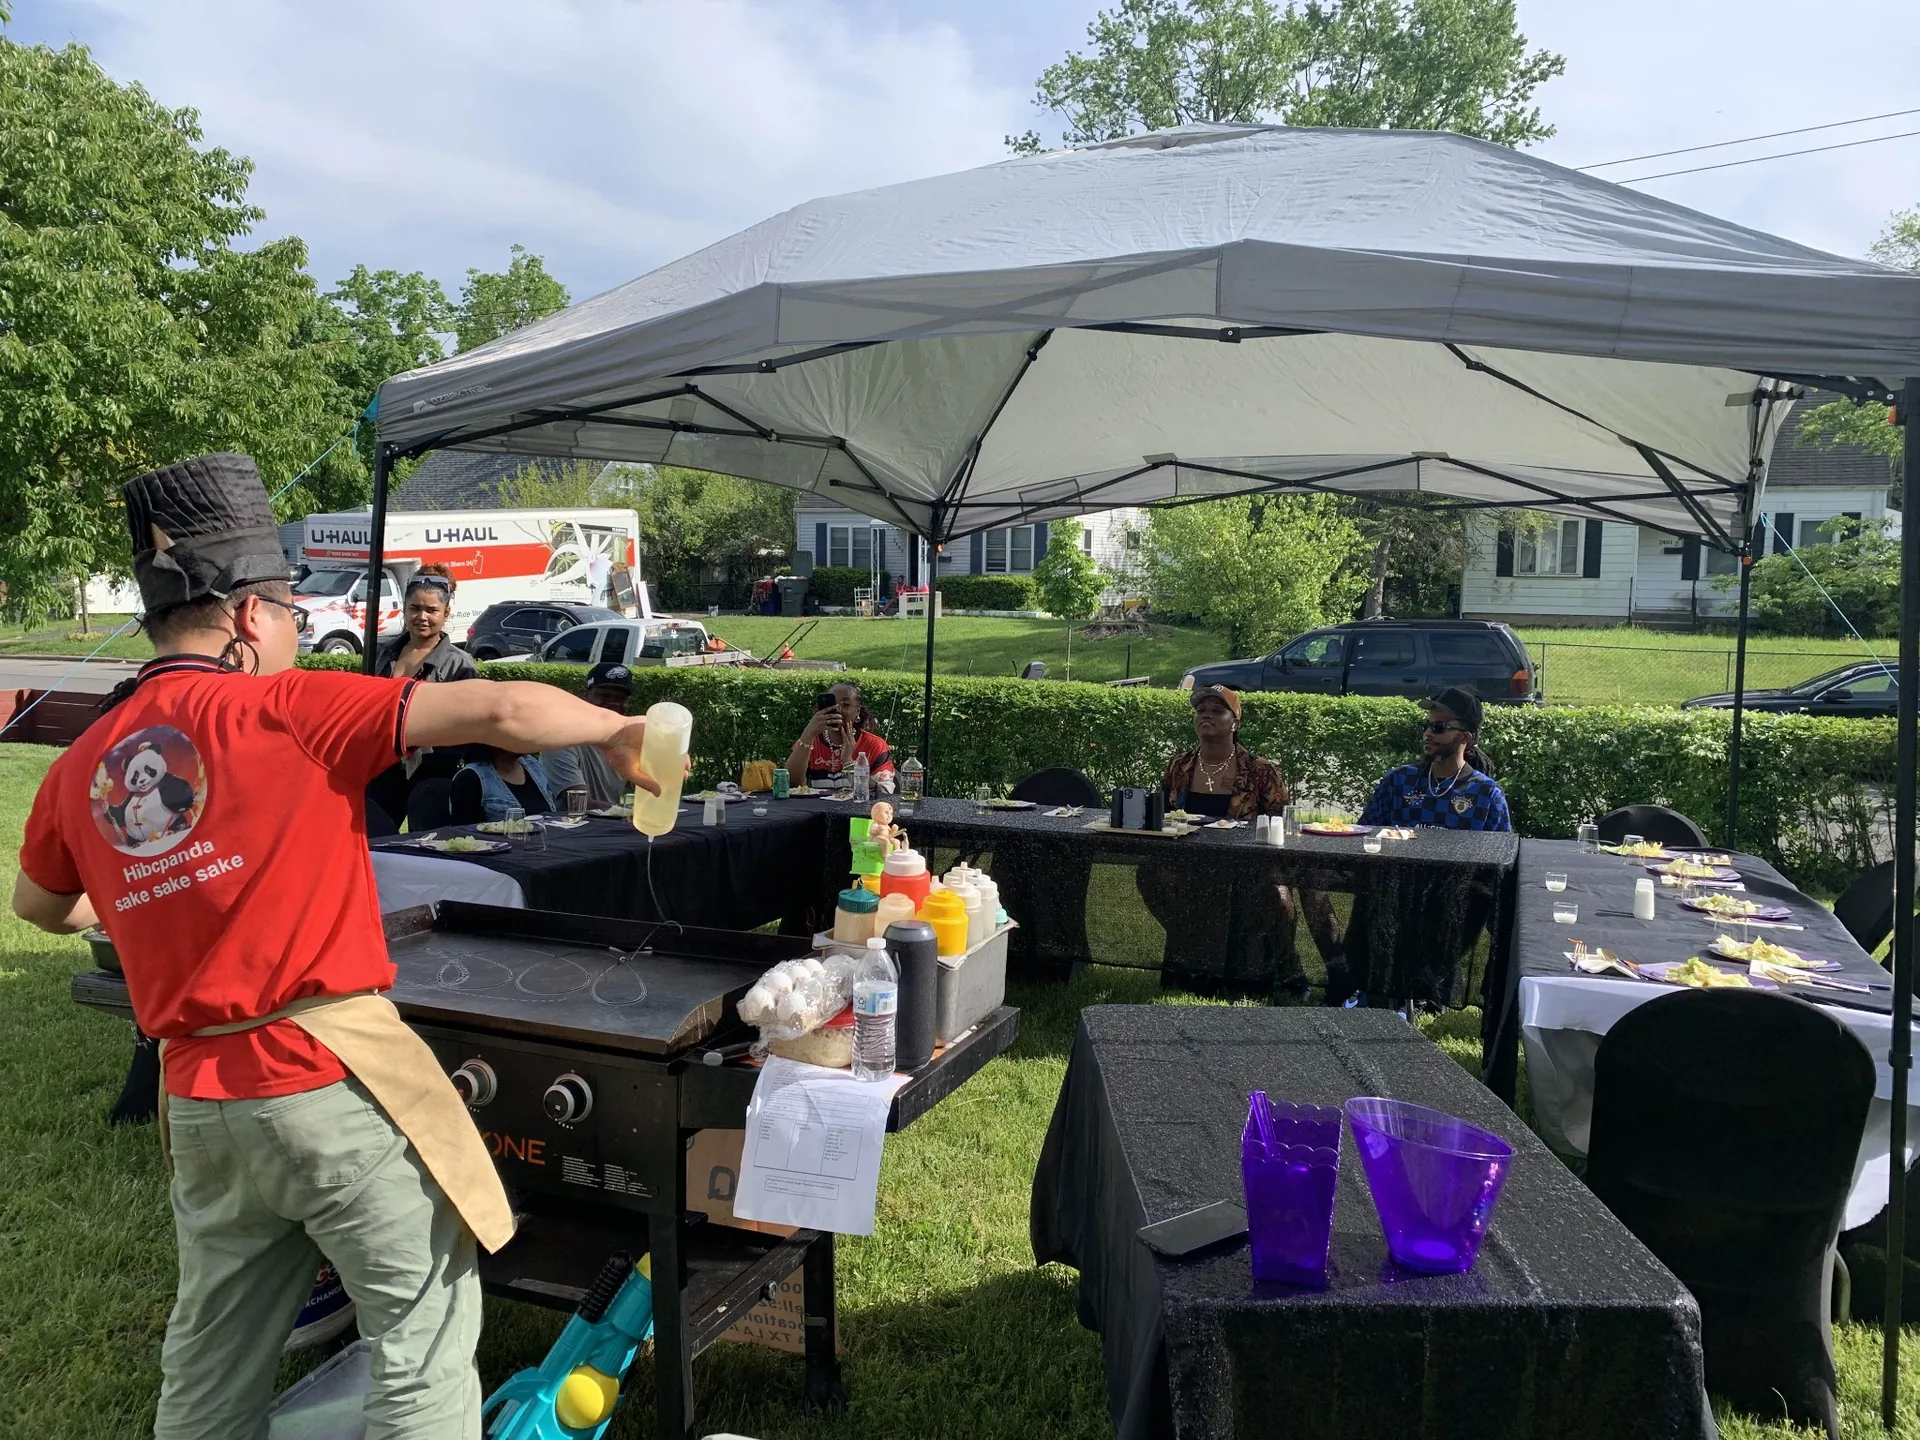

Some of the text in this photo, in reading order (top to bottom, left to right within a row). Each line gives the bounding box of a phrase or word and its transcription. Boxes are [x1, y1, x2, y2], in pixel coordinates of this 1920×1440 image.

[114, 854, 244, 912] sake sake sake
[122, 840, 215, 883] Hibcpanda
